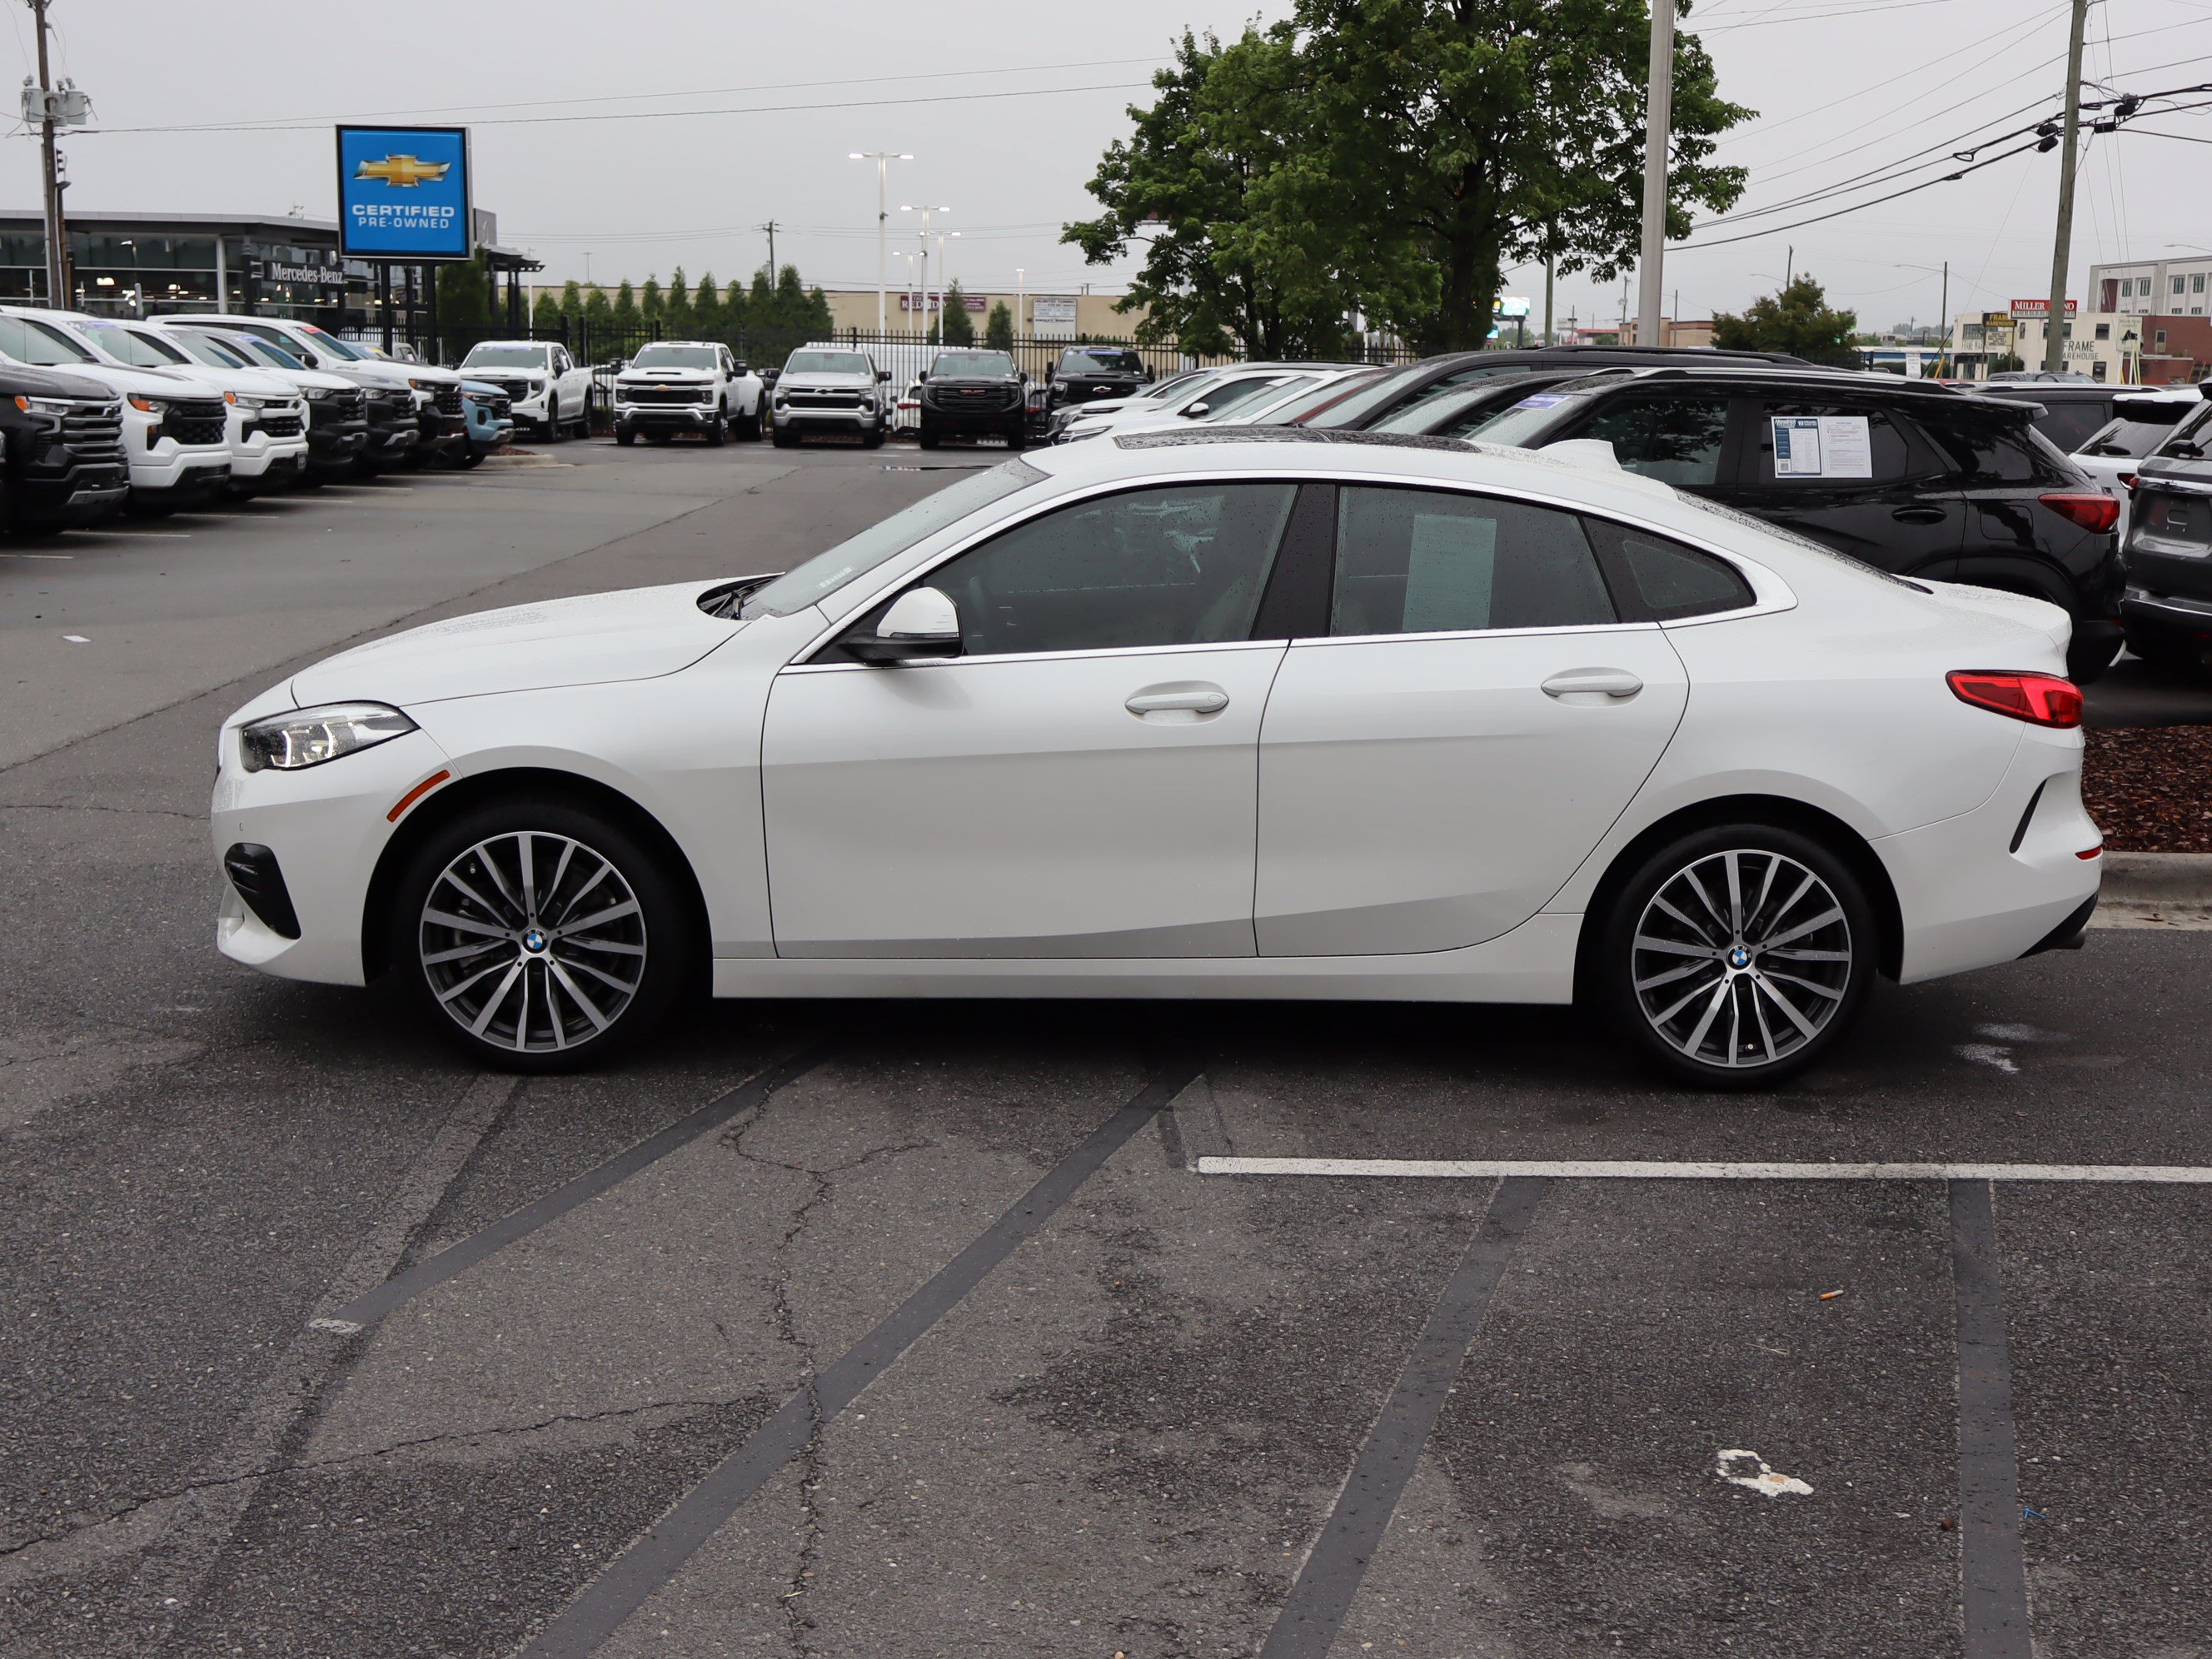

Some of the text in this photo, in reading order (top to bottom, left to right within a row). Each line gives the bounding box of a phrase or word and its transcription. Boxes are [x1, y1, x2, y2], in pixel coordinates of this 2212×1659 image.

[351, 204, 456, 218] CERTIFIED
[358, 217, 450, 229] PRE-OWNED
[272, 262, 344, 284] Mercedes-Benz
[2015, 301, 2045, 311] MILLER
